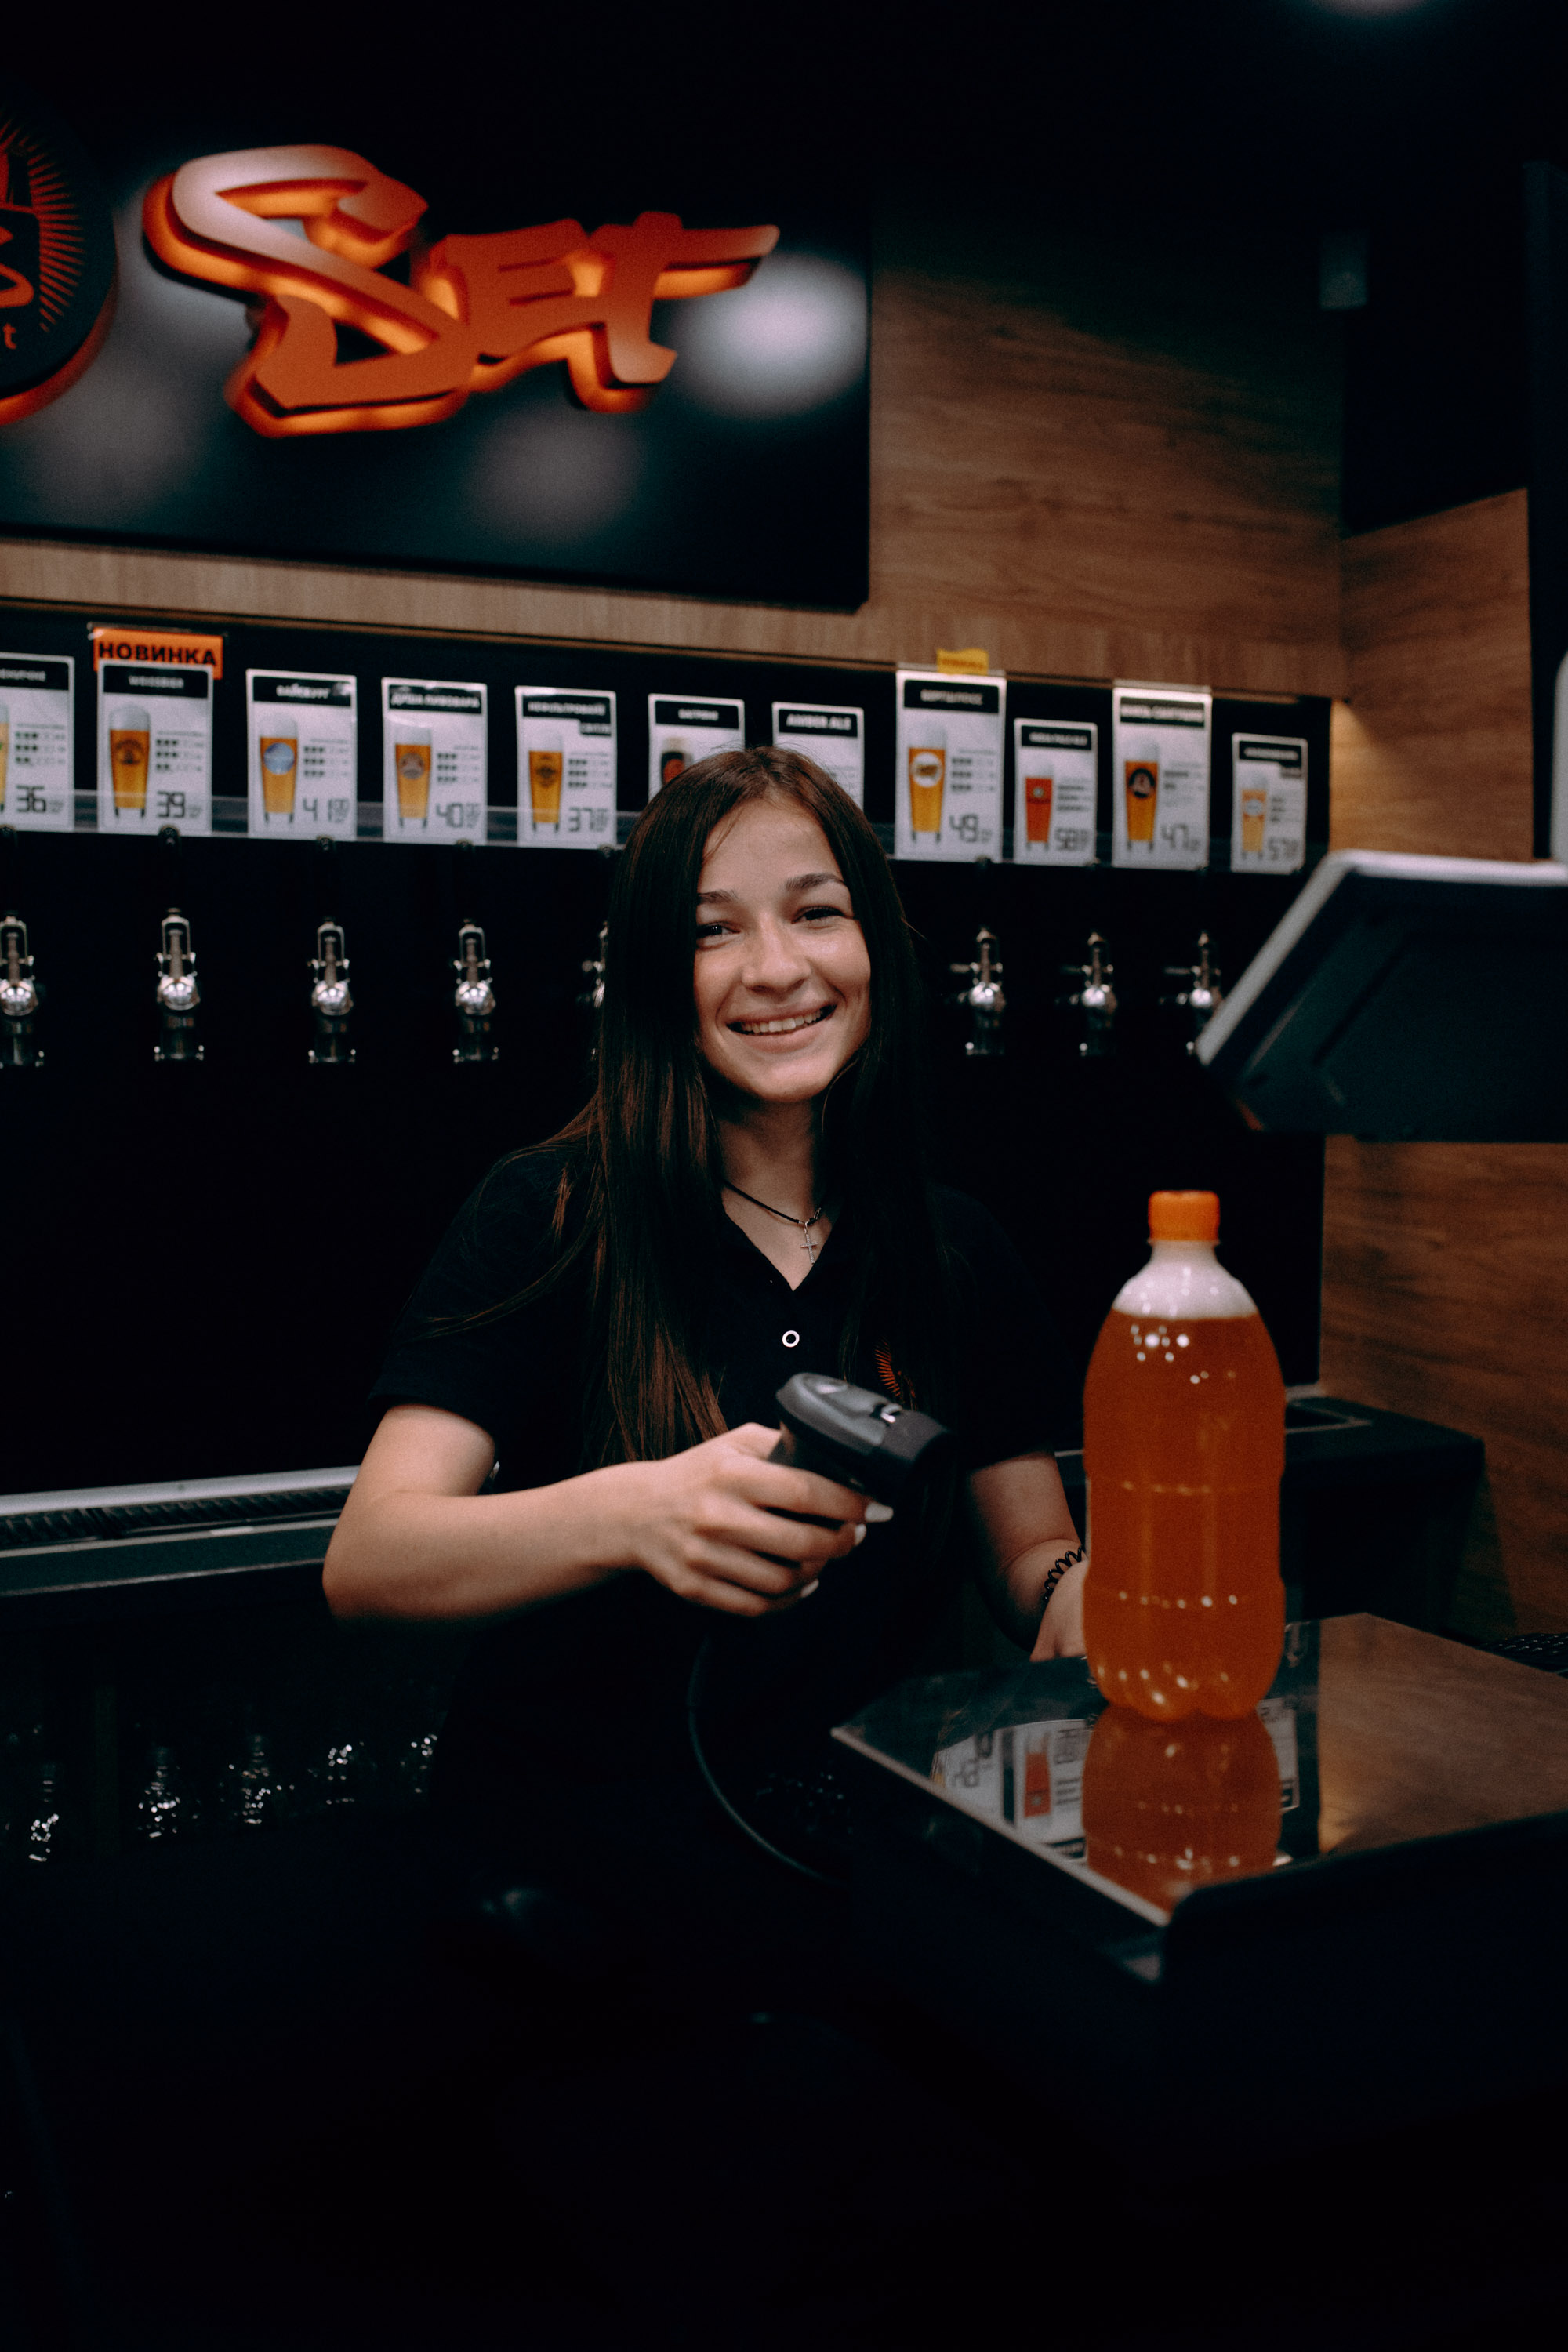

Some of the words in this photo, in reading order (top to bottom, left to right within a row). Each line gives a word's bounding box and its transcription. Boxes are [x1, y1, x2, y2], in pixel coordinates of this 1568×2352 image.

[100, 642, 216, 666] НОВИНКА
[16, 786, 46, 812] 36
[156, 790, 185, 818] 39
[435, 802, 463, 827] 40
[949, 814, 978, 842] 49
